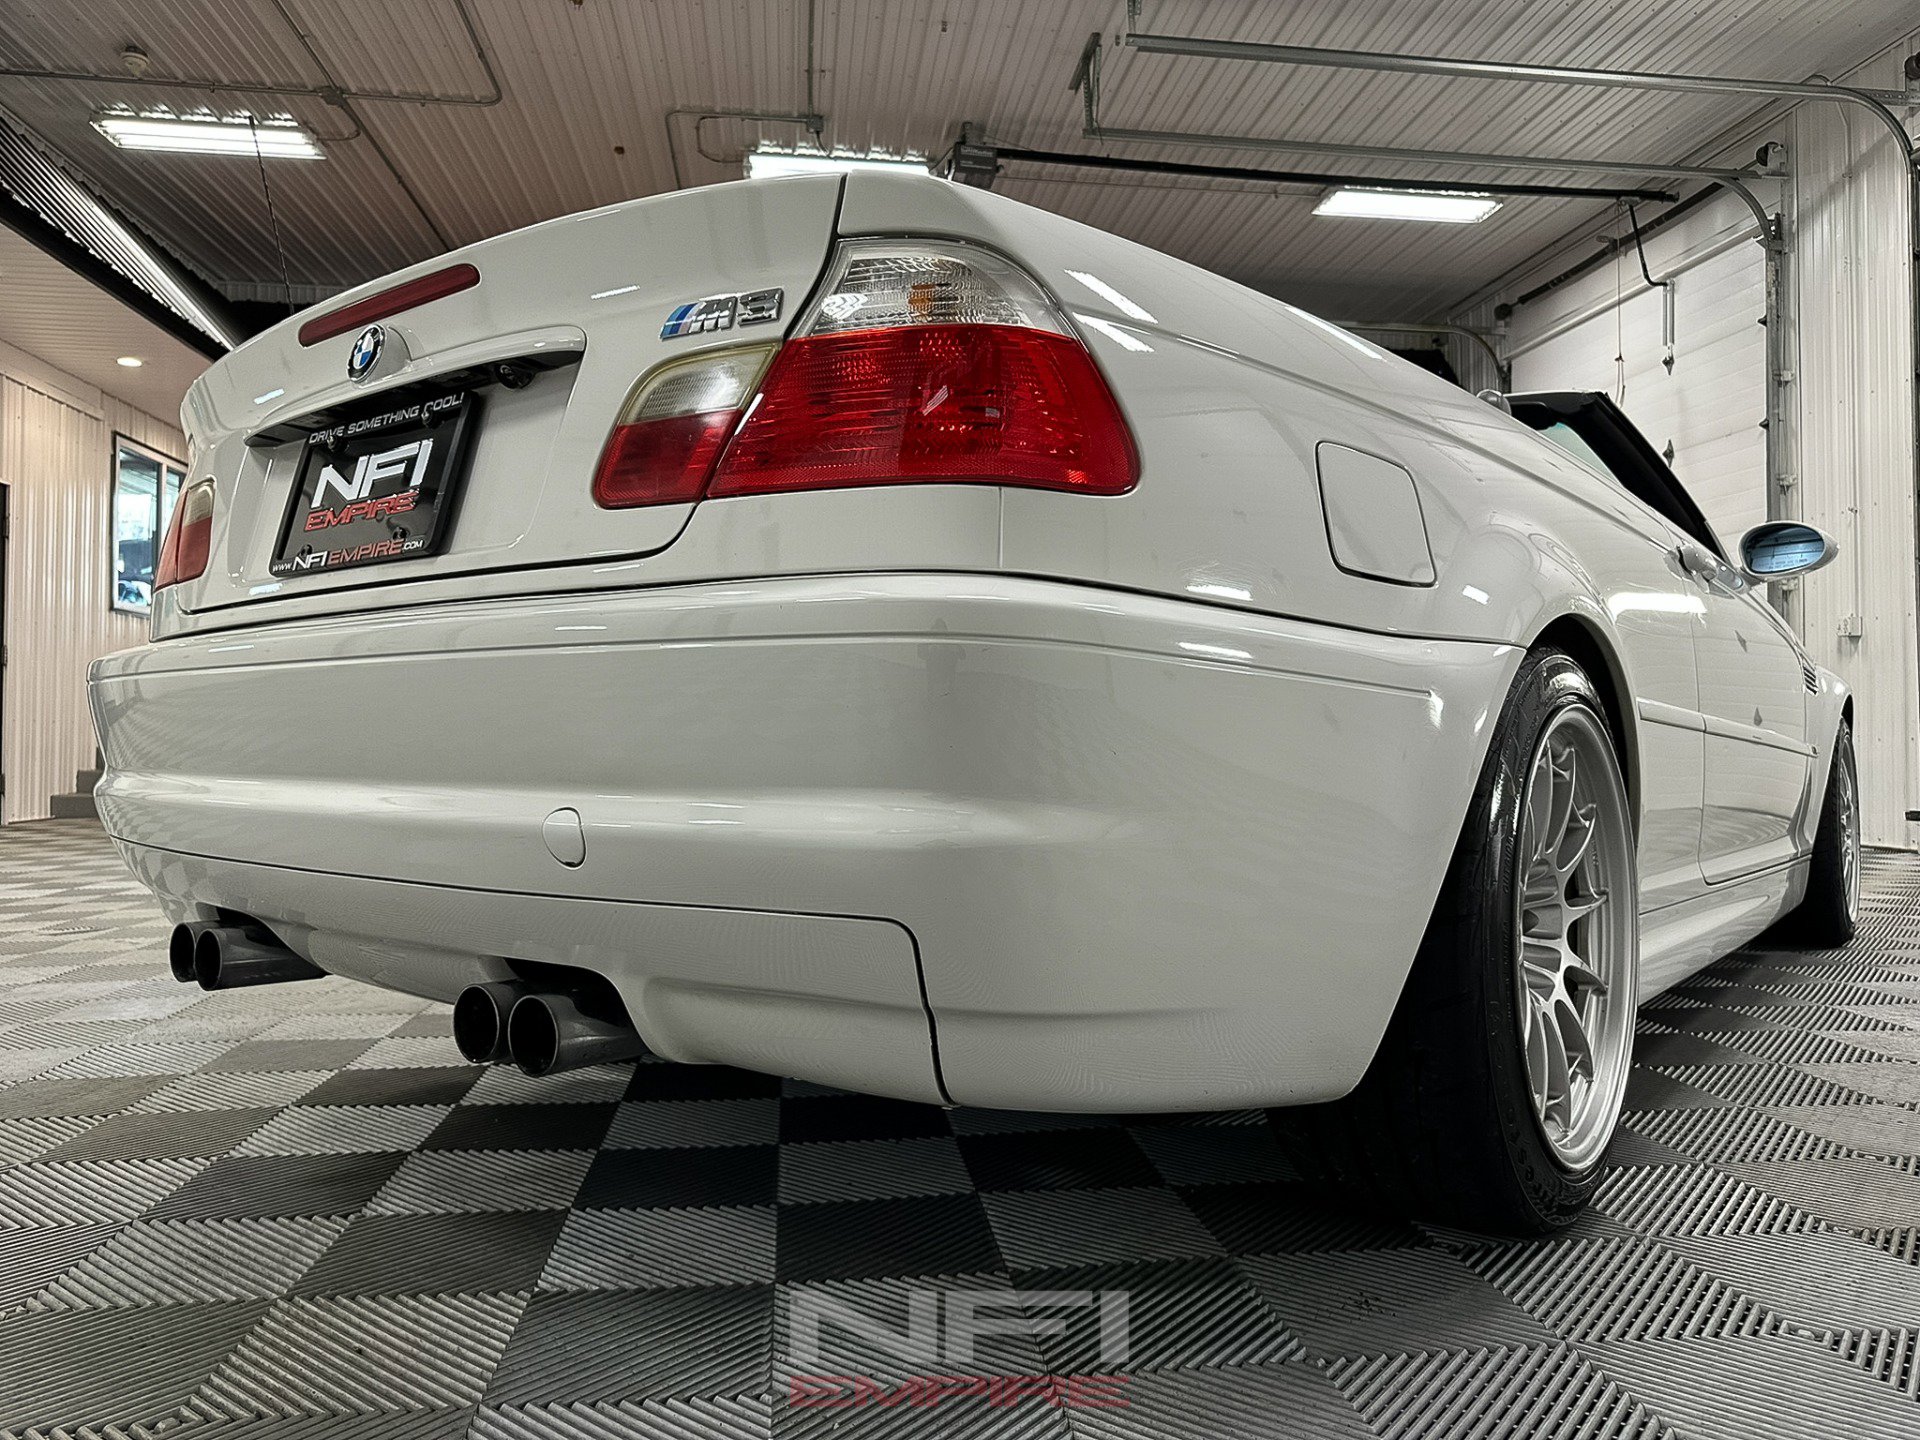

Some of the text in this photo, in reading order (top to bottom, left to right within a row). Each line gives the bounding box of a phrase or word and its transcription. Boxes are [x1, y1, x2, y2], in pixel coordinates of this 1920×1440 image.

[676, 287, 784, 337] M3
[308, 392, 465, 444] DRIVE SOMETHING COOL!
[310, 438, 434, 509] NFI
[303, 488, 420, 532] EMPIRE
